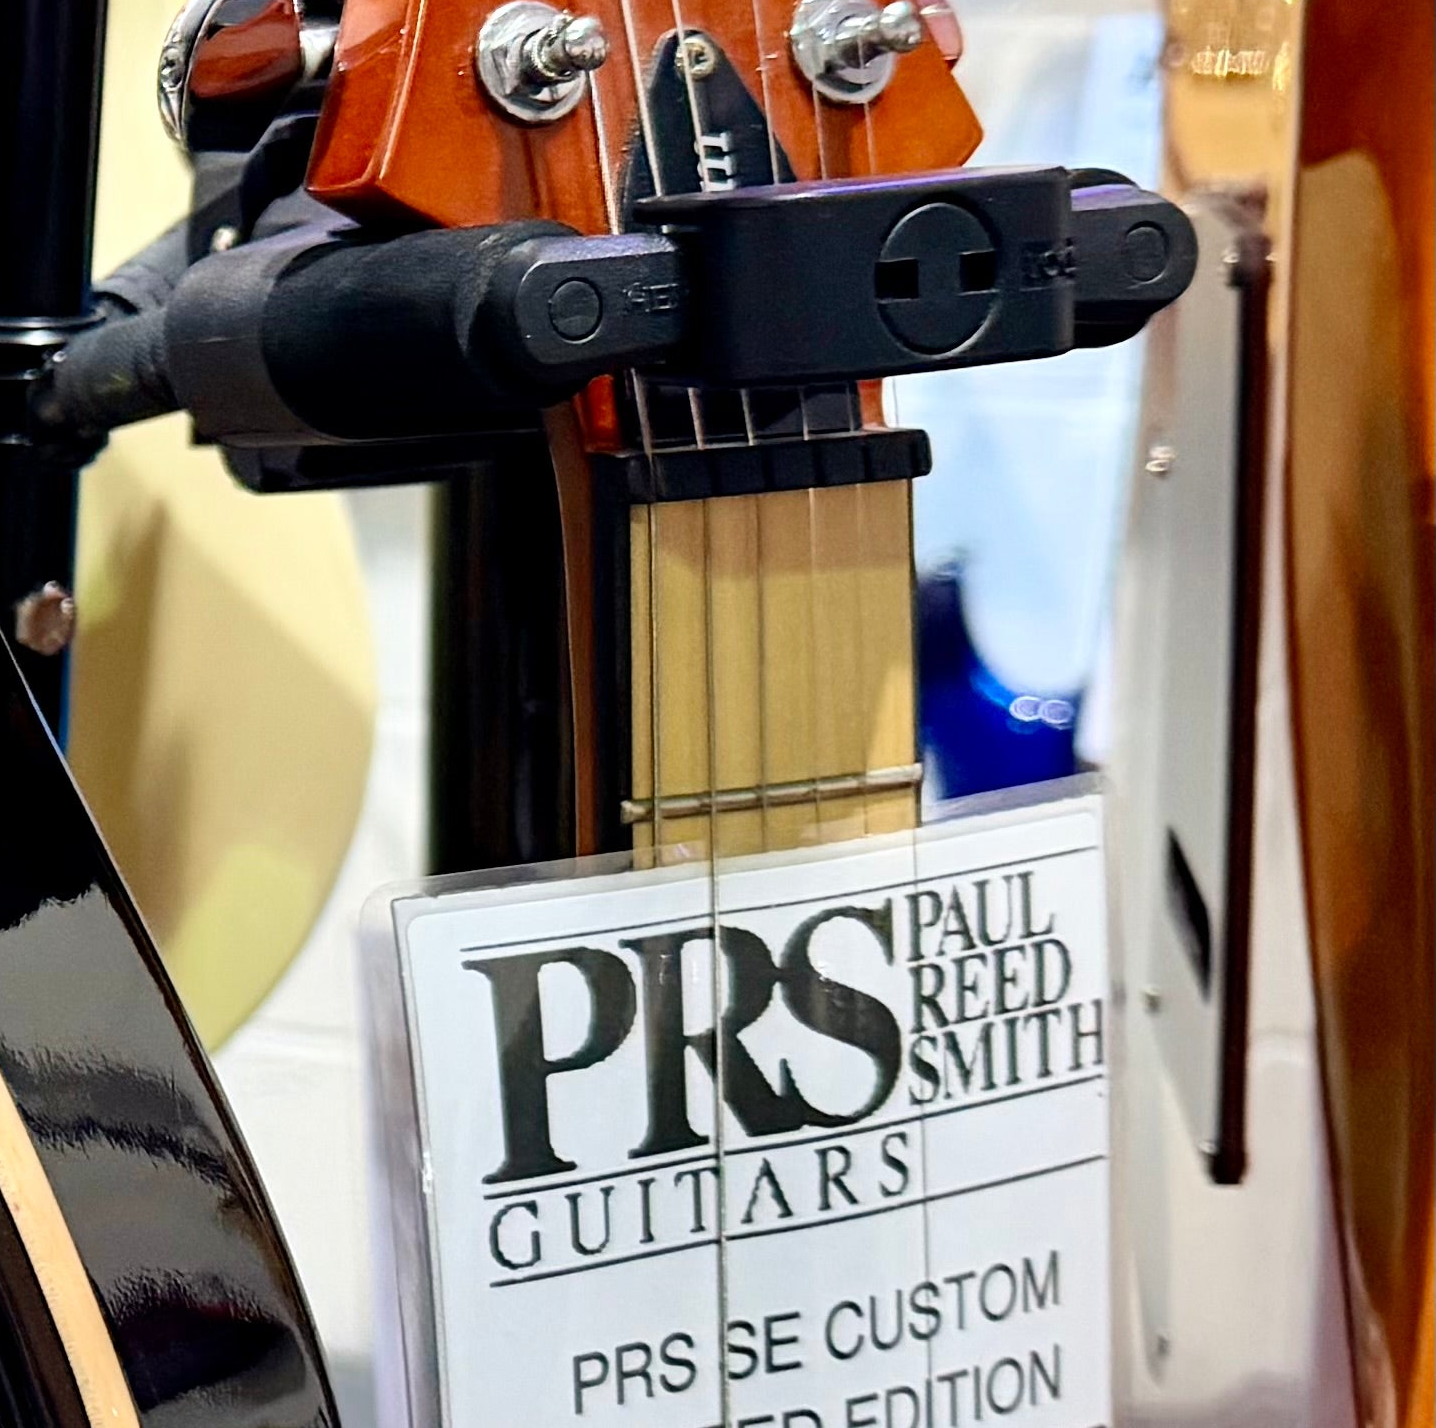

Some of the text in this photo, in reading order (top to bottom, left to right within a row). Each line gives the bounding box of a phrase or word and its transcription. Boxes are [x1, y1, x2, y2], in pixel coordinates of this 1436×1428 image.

[905, 869, 1055, 965] PAUL
[462, 899, 902, 1184] PRS
[908, 938, 1073, 1036] REED
[908, 997, 1105, 1108] SMITH
[489, 1131, 913, 1272] GUITARS
[571, 1249, 1062, 1415] PRS SE CUSTOM
